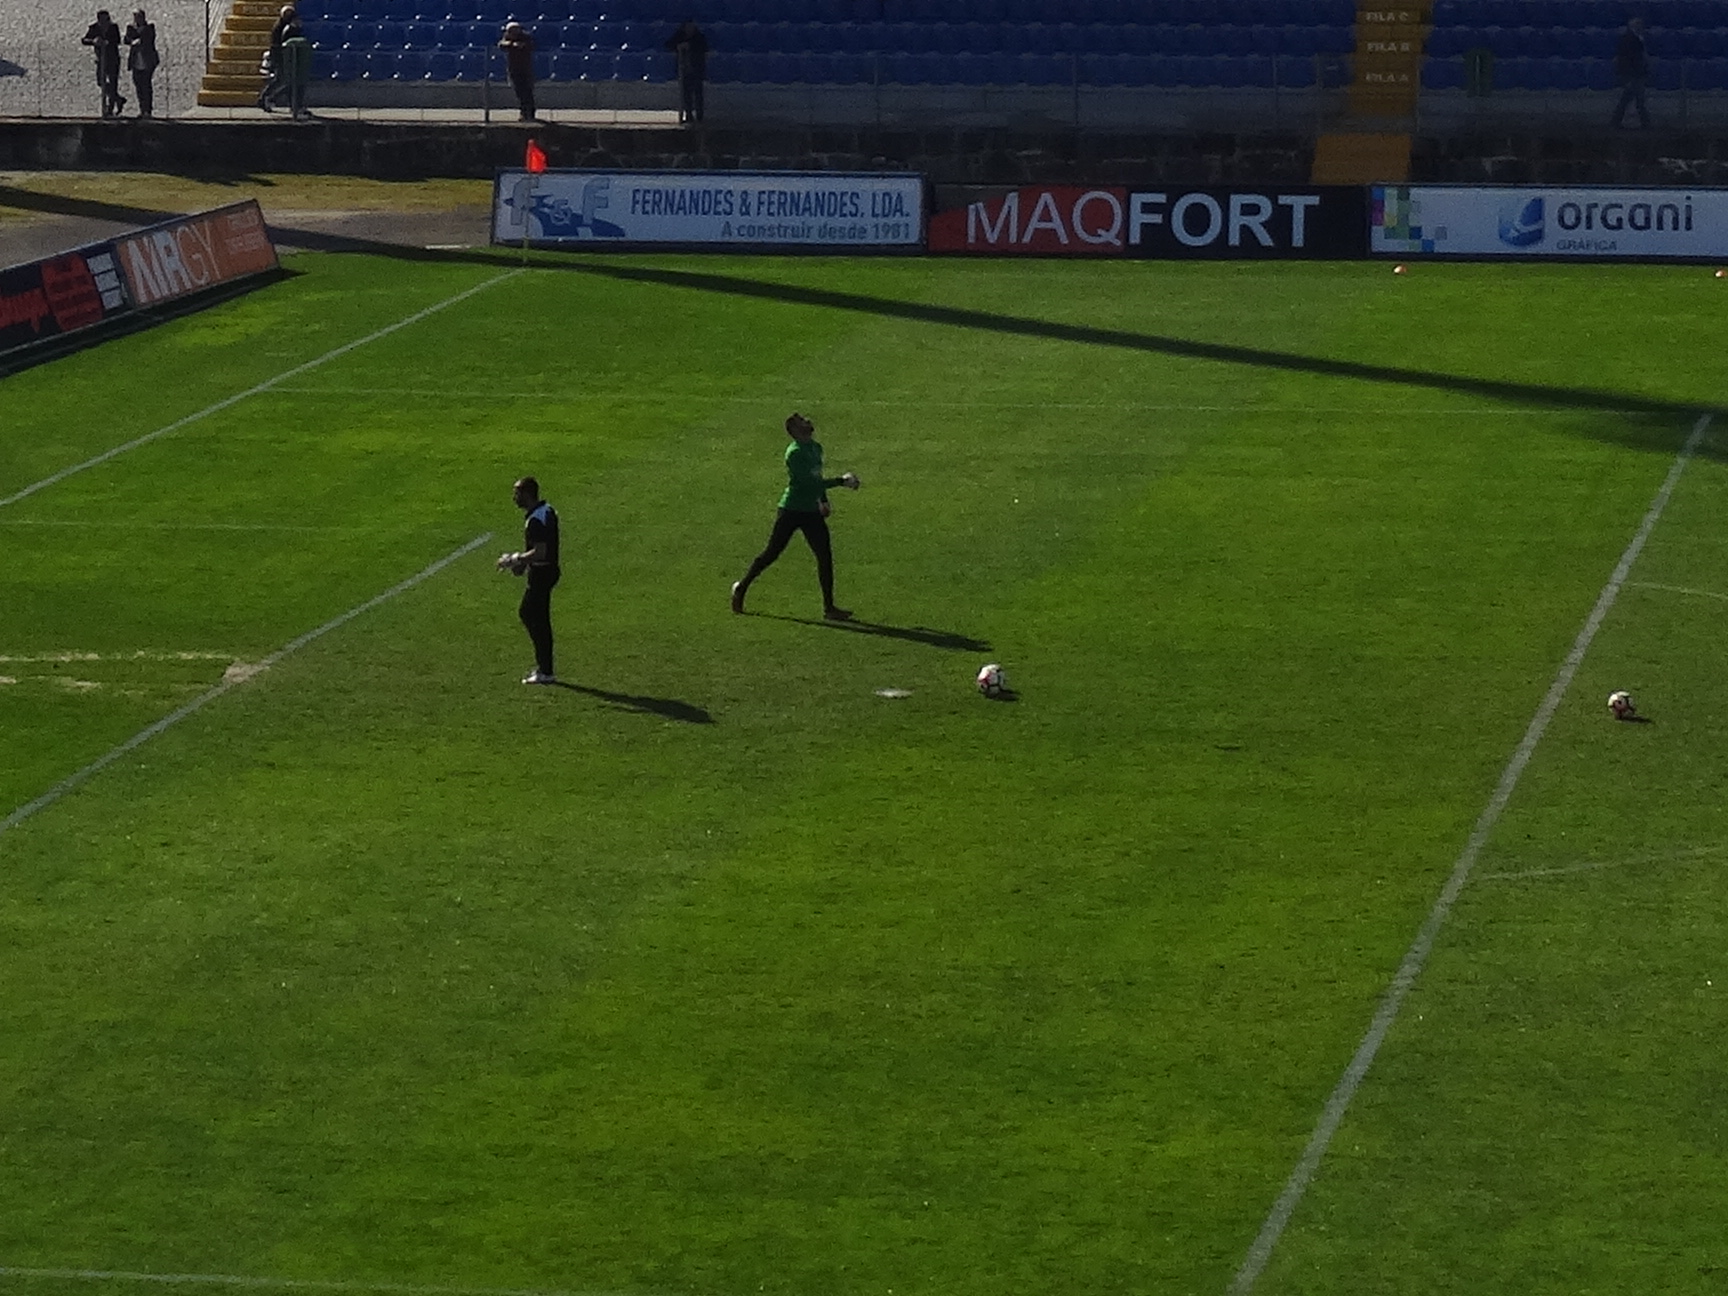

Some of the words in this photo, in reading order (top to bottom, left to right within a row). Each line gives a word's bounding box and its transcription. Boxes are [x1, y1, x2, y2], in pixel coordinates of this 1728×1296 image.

[631, 189, 734, 216] FERNANDES
[739, 190, 751, 217] &
[871, 192, 910, 218] LDA.
[736, 222, 812, 239] construir
[816, 223, 868, 240] desde
[872, 223, 910, 240] 1981
[967, 191, 1320, 247] MAQFORT
